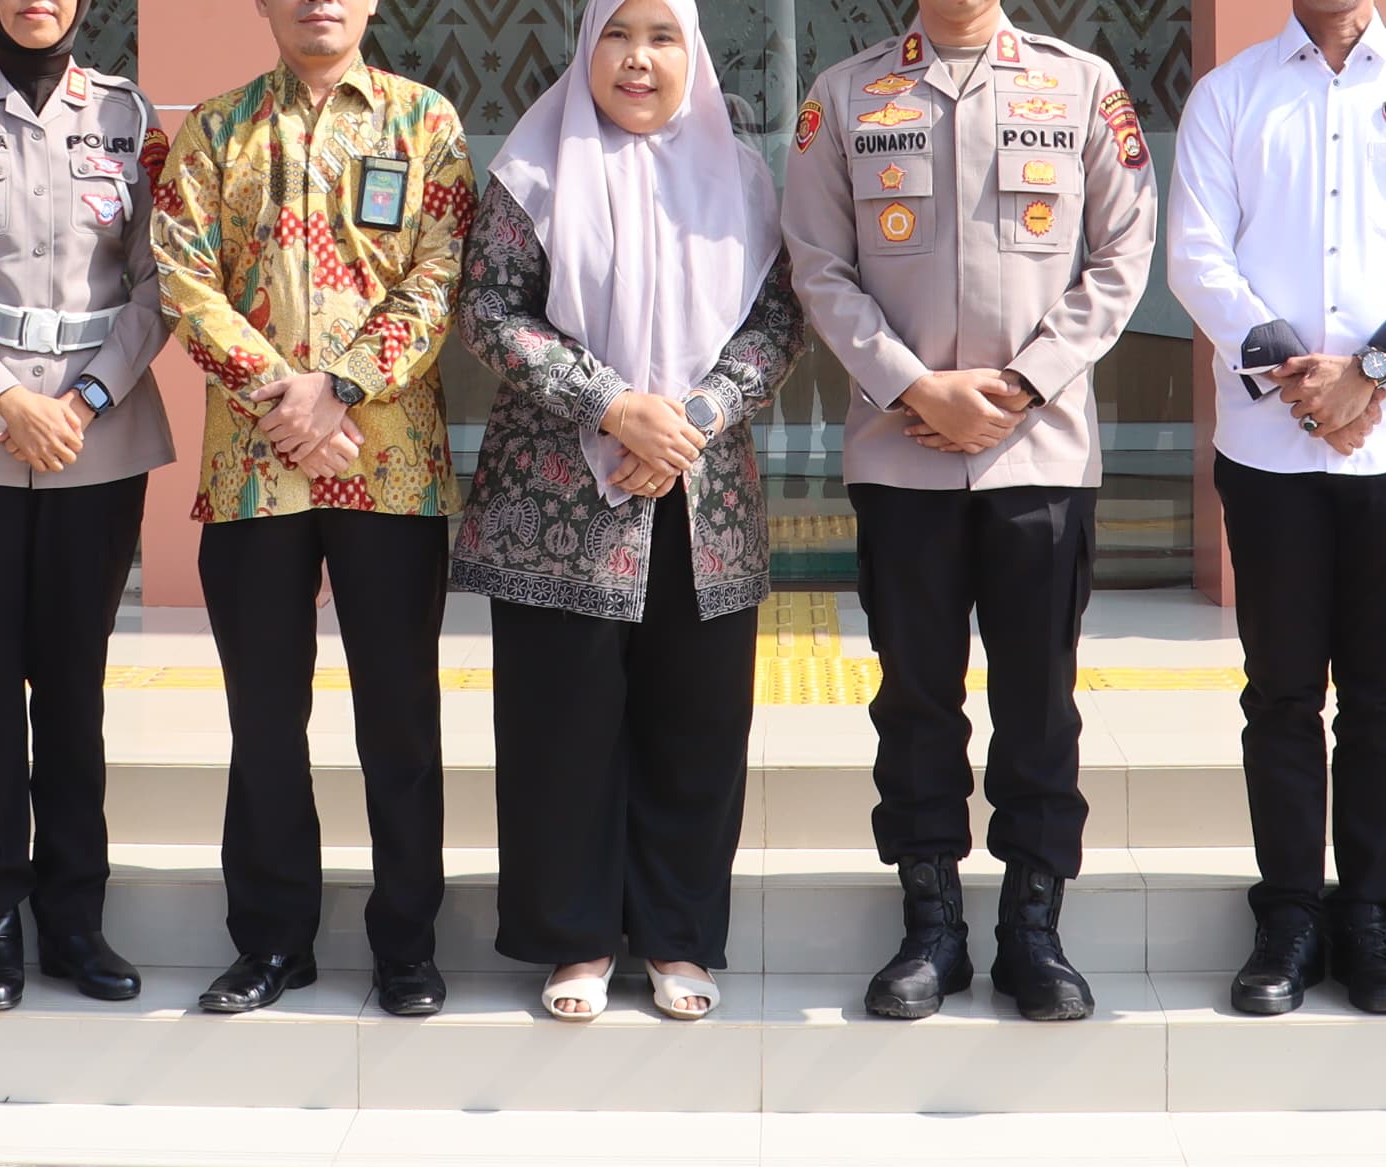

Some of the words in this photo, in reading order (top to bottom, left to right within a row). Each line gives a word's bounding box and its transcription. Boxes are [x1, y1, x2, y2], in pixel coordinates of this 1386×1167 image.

[66, 134, 135, 154] POLRI
[854, 131, 927, 155] GUNARTO
[1002, 130, 1075, 150] POLRI
